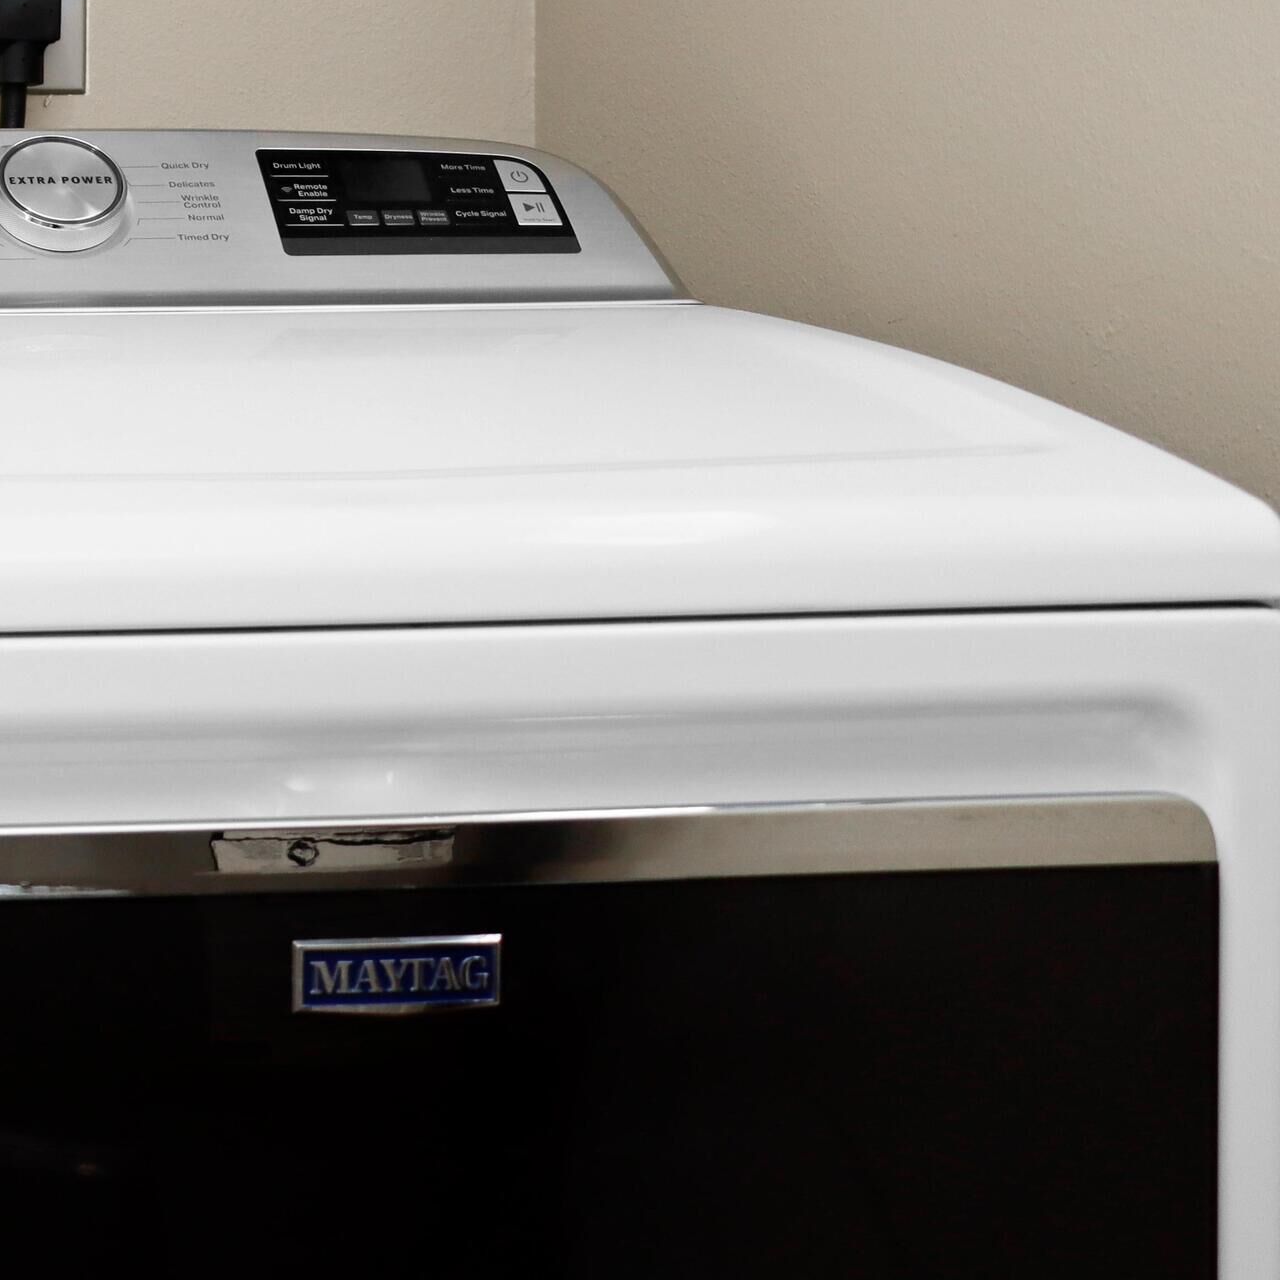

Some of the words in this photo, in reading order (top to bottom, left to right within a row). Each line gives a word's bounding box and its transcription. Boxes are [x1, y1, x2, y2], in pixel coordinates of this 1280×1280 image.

[160, 161, 190, 170] Quick
[191, 161, 209, 170] Dry
[298, 162, 321, 170] Light
[9, 175, 57, 185] EXTRA
[61, 175, 113, 185] POWER
[183, 201, 221, 209] Control
[289, 207, 316, 215] Damp
[316, 207, 333, 215] Dry
[455, 210, 479, 218] Cycle
[188, 213, 225, 221] Normal
[299, 214, 328, 222] Signal
[177, 232, 209, 241] Timed
[210, 232, 230, 242] Dry
[310, 955, 489, 995] MAYTAG
